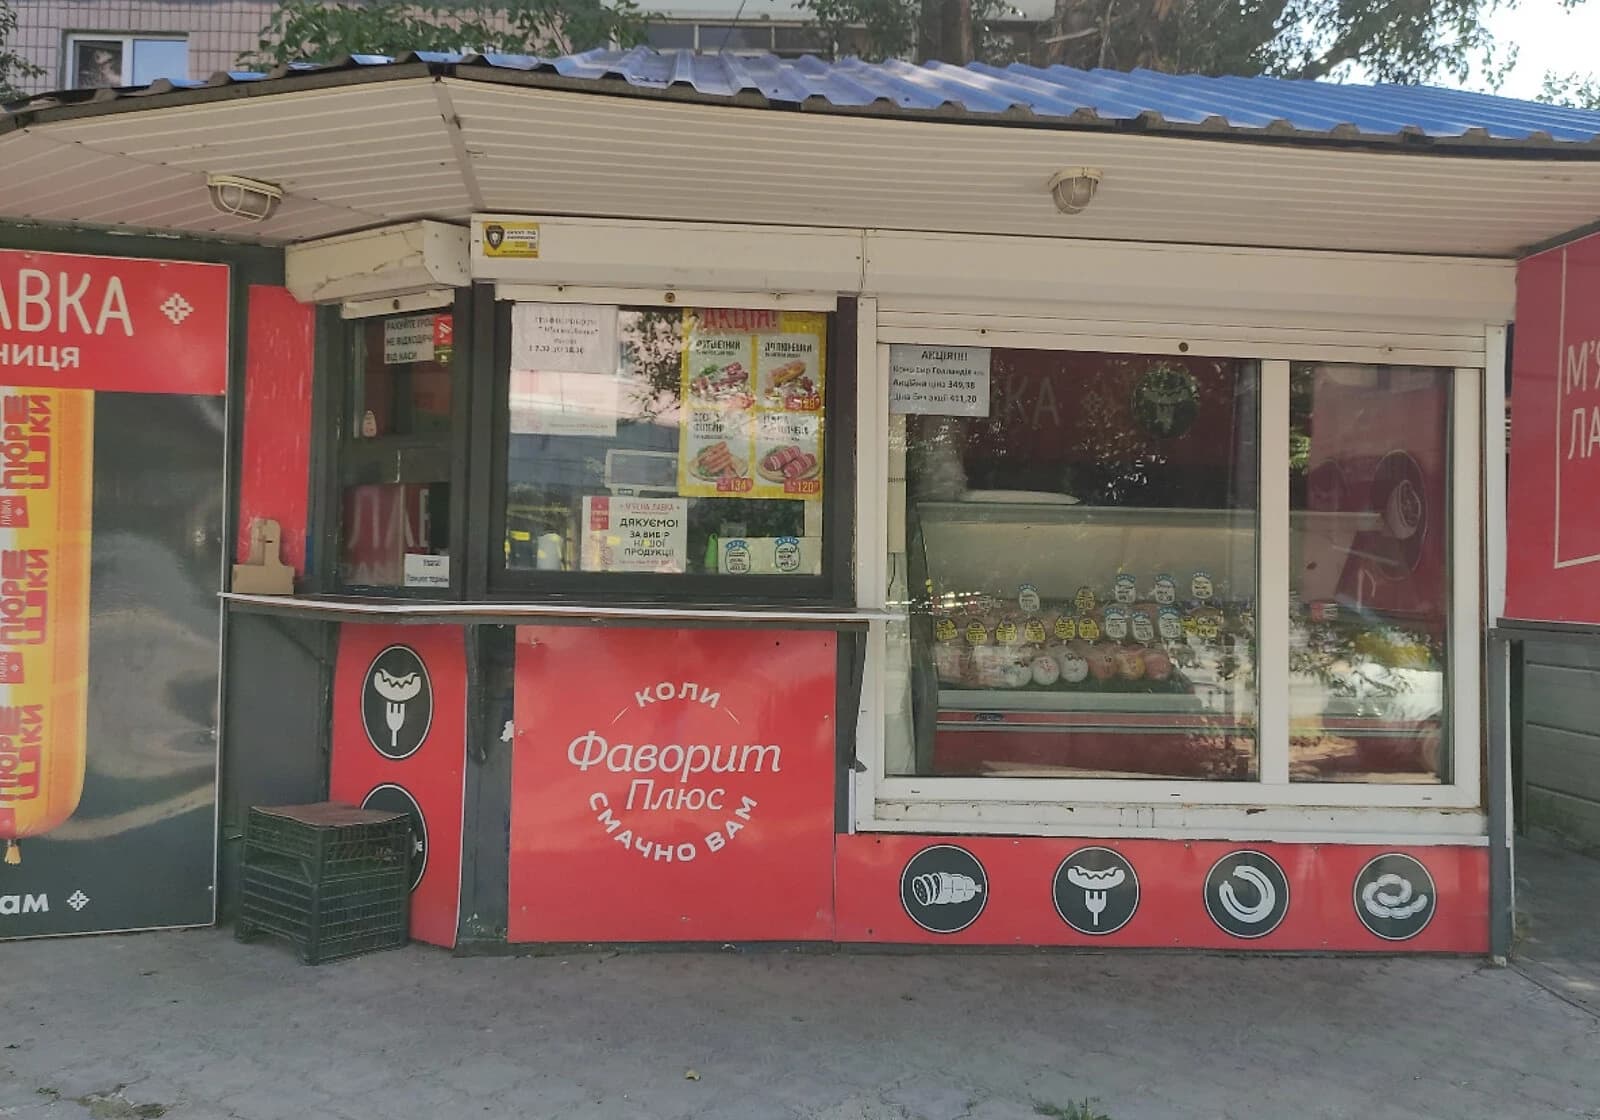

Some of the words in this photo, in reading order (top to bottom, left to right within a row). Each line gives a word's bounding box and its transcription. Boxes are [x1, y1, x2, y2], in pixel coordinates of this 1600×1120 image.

[619, 517, 679, 529] ДЯКУЄМО!
[634, 681, 721, 709] КОЛИ
[567, 730, 782, 783] Фаворит
[625, 778, 727, 811] Плюс
[588, 791, 697, 863] СМАЧНО
[704, 795, 758, 853] ВАМ
